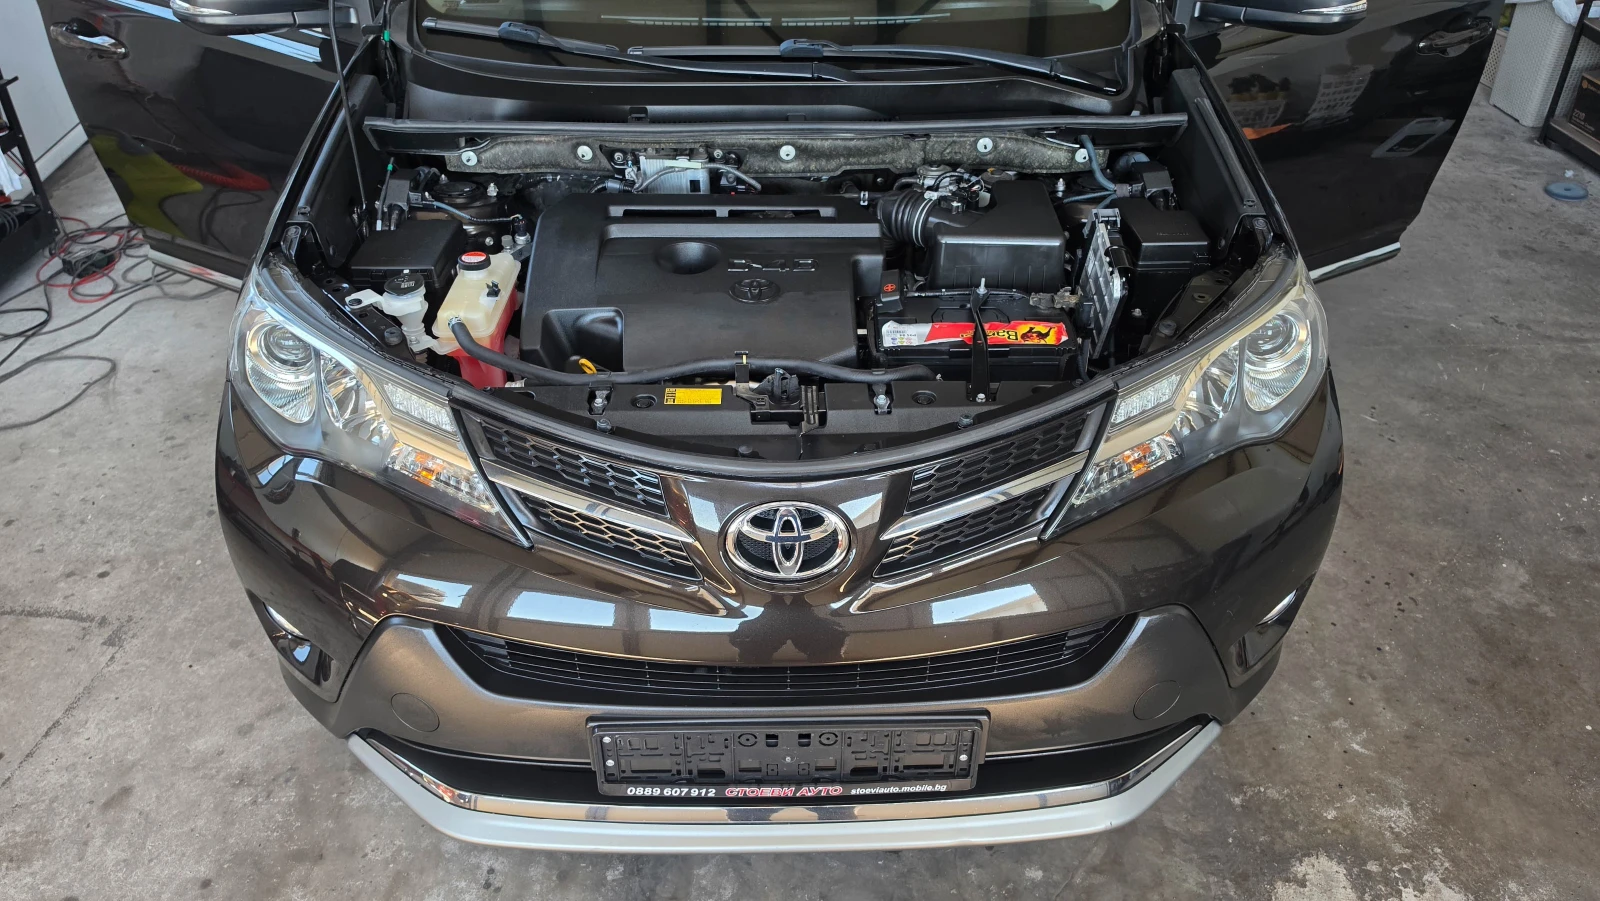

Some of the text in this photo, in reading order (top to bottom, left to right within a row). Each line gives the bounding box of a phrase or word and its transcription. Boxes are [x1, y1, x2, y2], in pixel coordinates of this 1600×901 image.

[626, 786, 716, 797] 0889 607 912
[725, 785, 843, 797] СТОЕВИ АУТО
[850, 783, 948, 795] stoeviauto.mobile.bg
